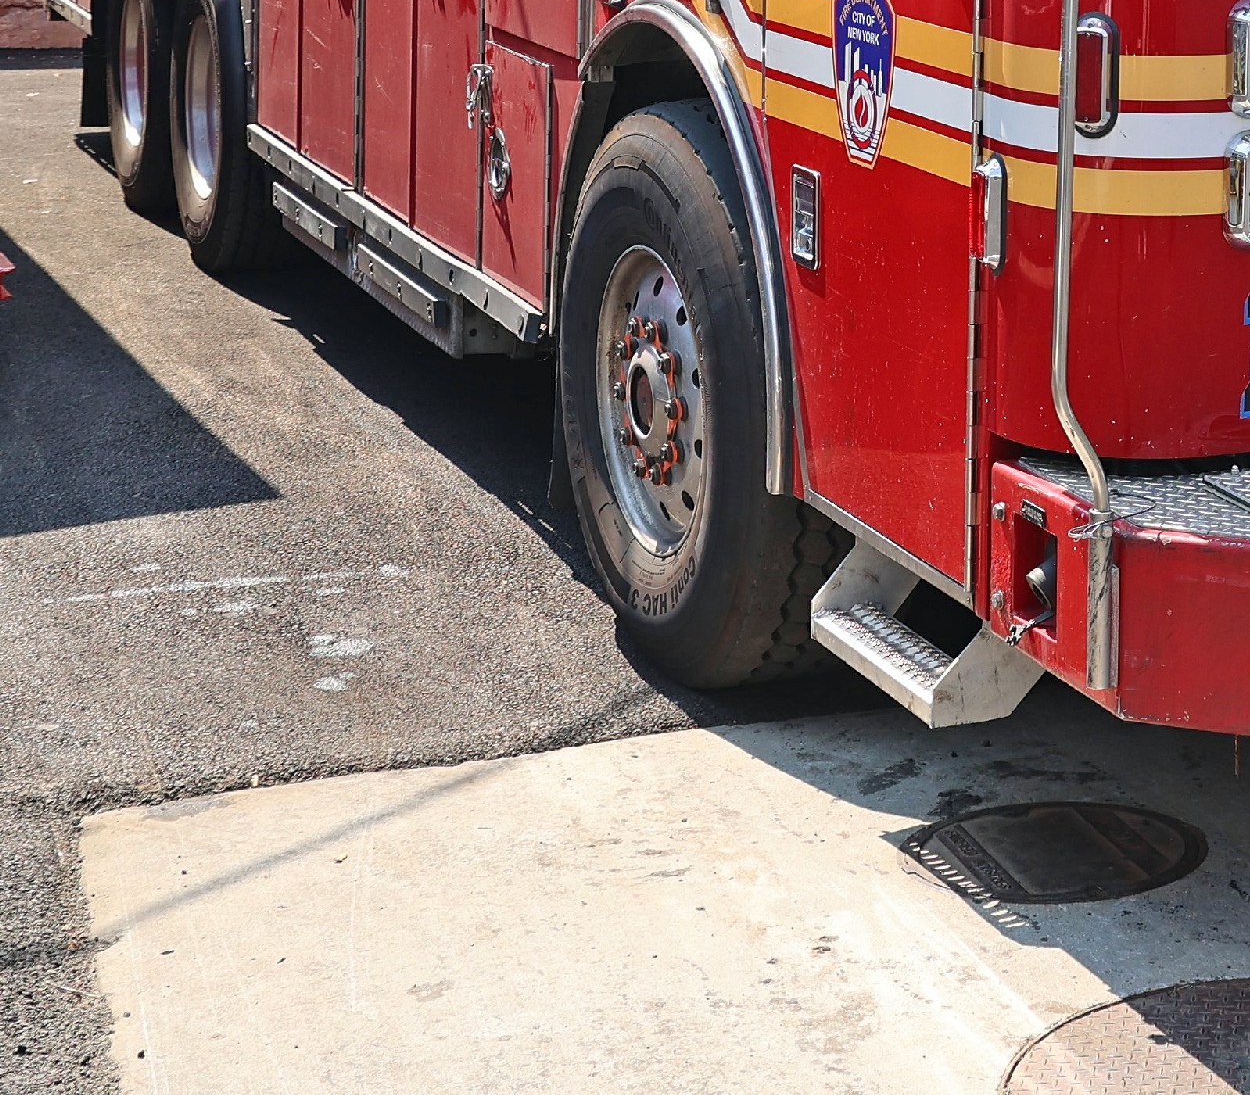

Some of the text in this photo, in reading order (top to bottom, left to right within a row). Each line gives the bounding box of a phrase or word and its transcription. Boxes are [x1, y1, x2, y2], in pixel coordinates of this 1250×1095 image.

[852, 10, 876, 27] CITY OF
[847, 26, 880, 46] NEW YORK
[642, 592, 668, 616] HAC
